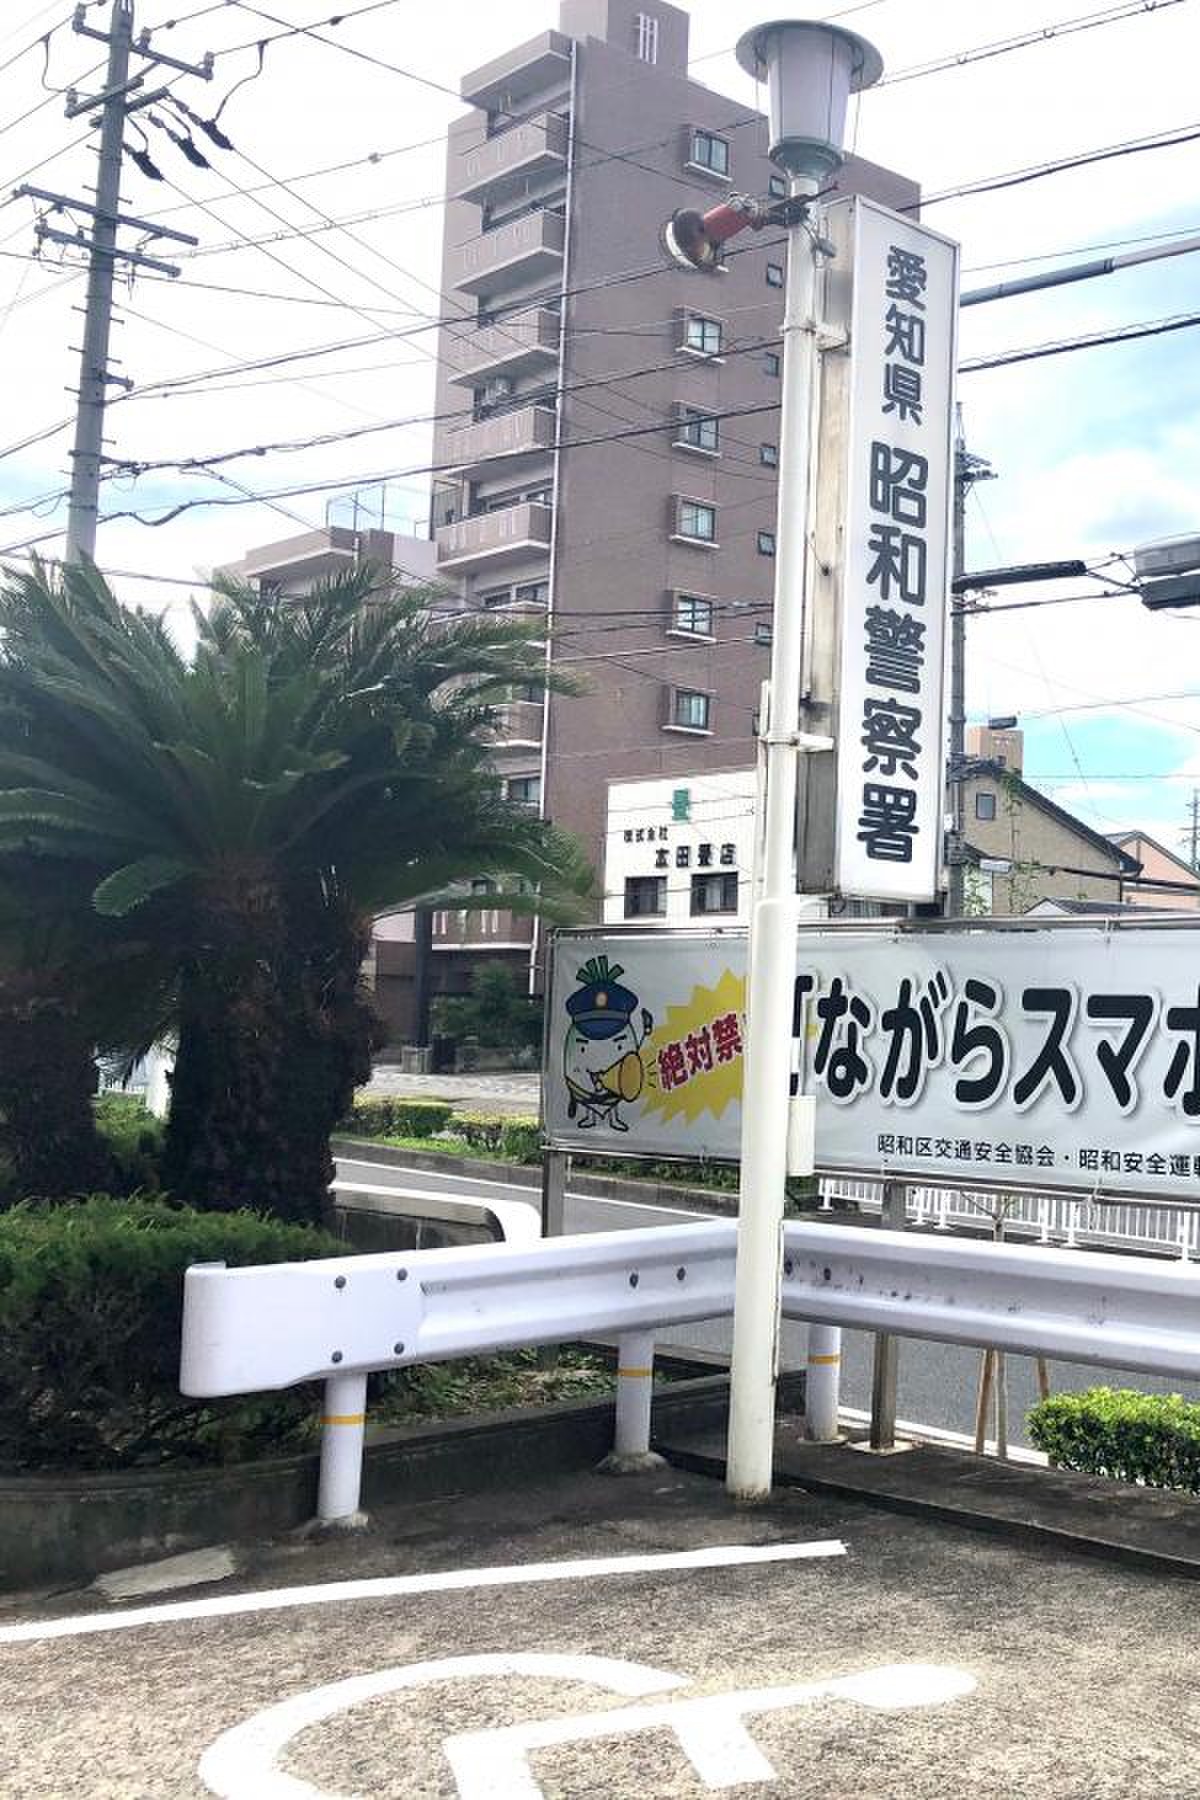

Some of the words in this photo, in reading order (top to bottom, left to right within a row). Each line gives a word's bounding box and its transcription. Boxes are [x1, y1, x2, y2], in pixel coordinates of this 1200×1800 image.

[881, 244, 928, 427] 愛知県
[856, 439, 930, 865] 昭和警察署
[657, 1012, 747, 1091] 絶対禁
